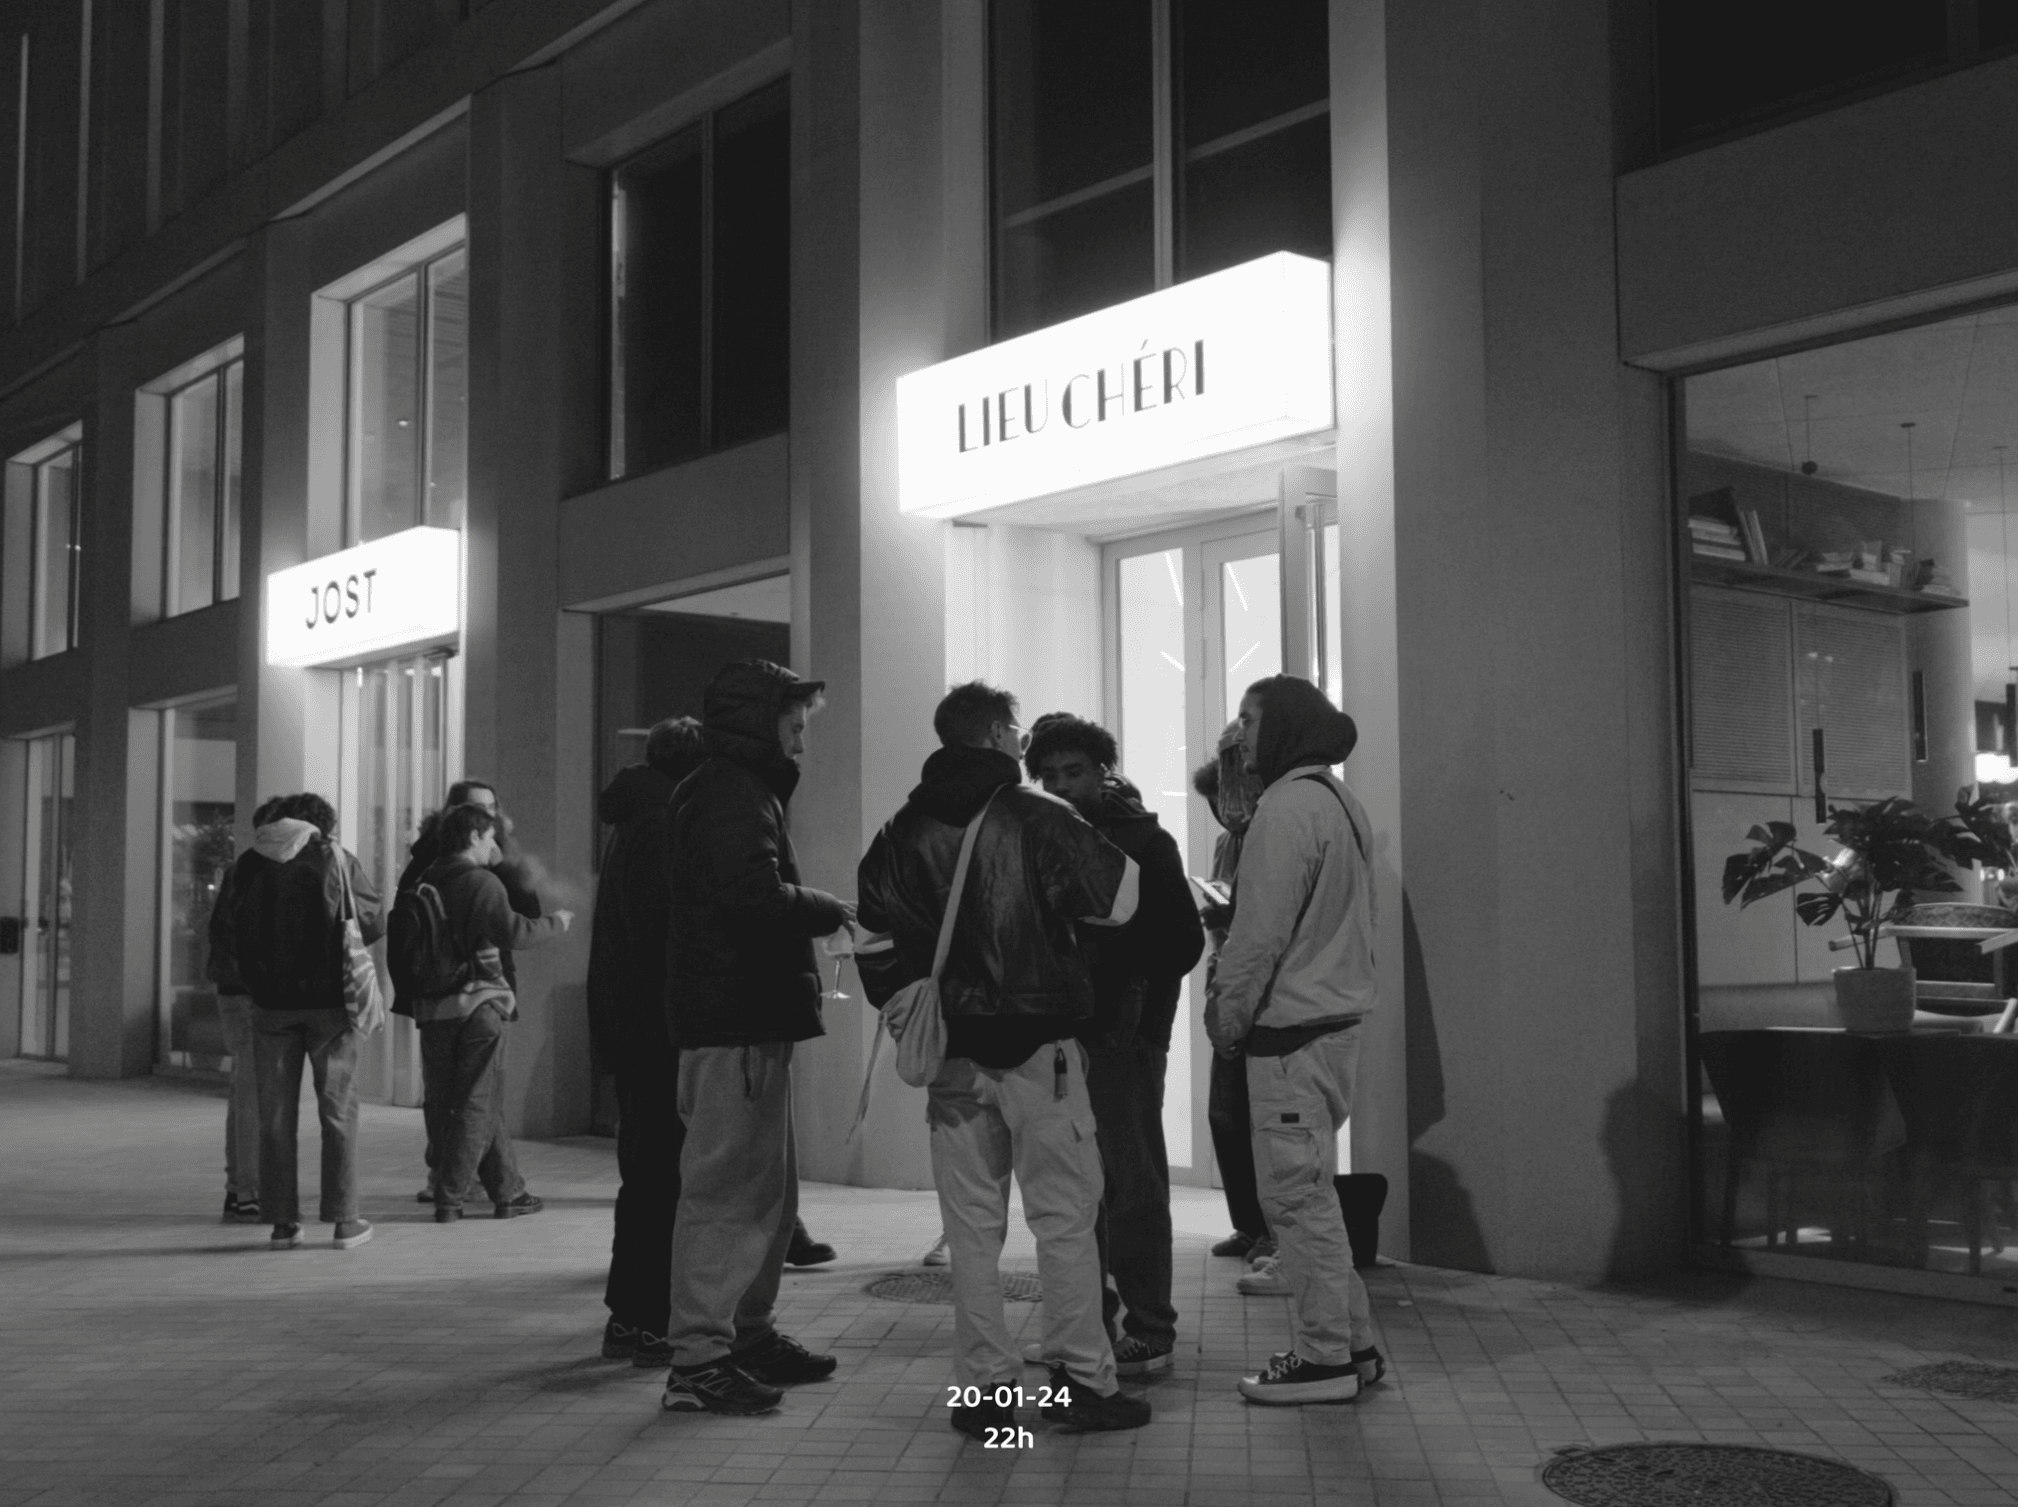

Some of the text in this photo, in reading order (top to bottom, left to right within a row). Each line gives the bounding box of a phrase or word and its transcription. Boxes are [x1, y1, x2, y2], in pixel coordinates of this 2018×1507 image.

[958, 338, 1205, 453] LIEU CHÉRI
[305, 568, 377, 630] JOST
